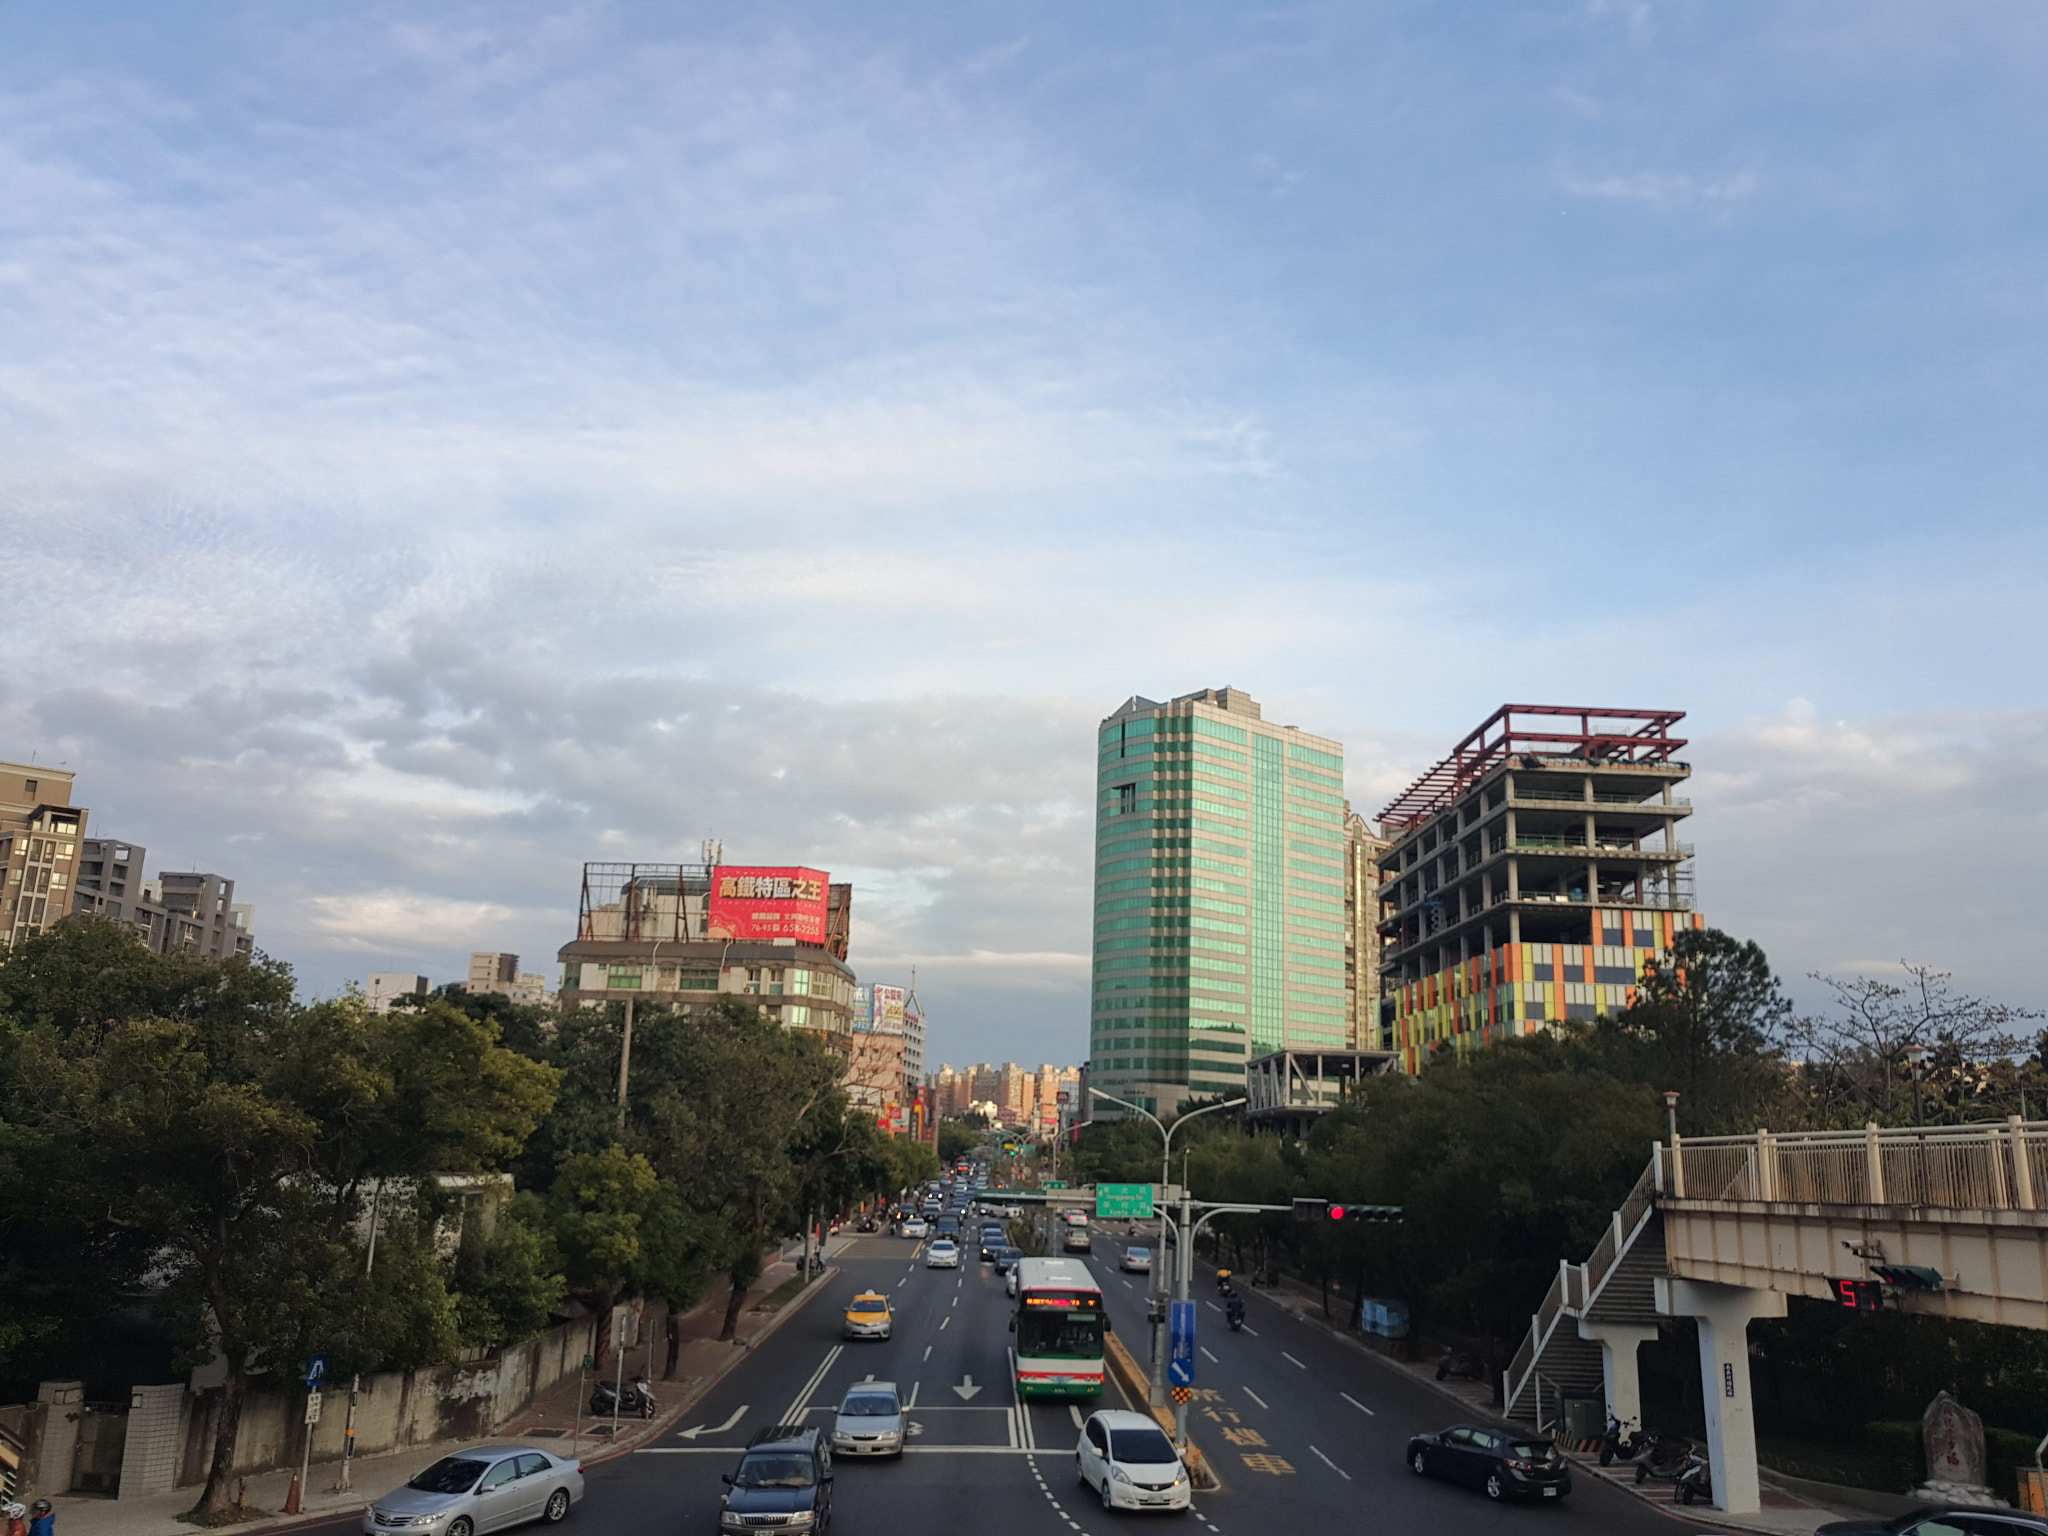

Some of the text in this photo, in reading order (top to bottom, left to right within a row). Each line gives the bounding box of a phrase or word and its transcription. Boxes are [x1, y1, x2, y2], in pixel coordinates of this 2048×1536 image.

[719, 876, 822, 902] 高鐵特區之王
